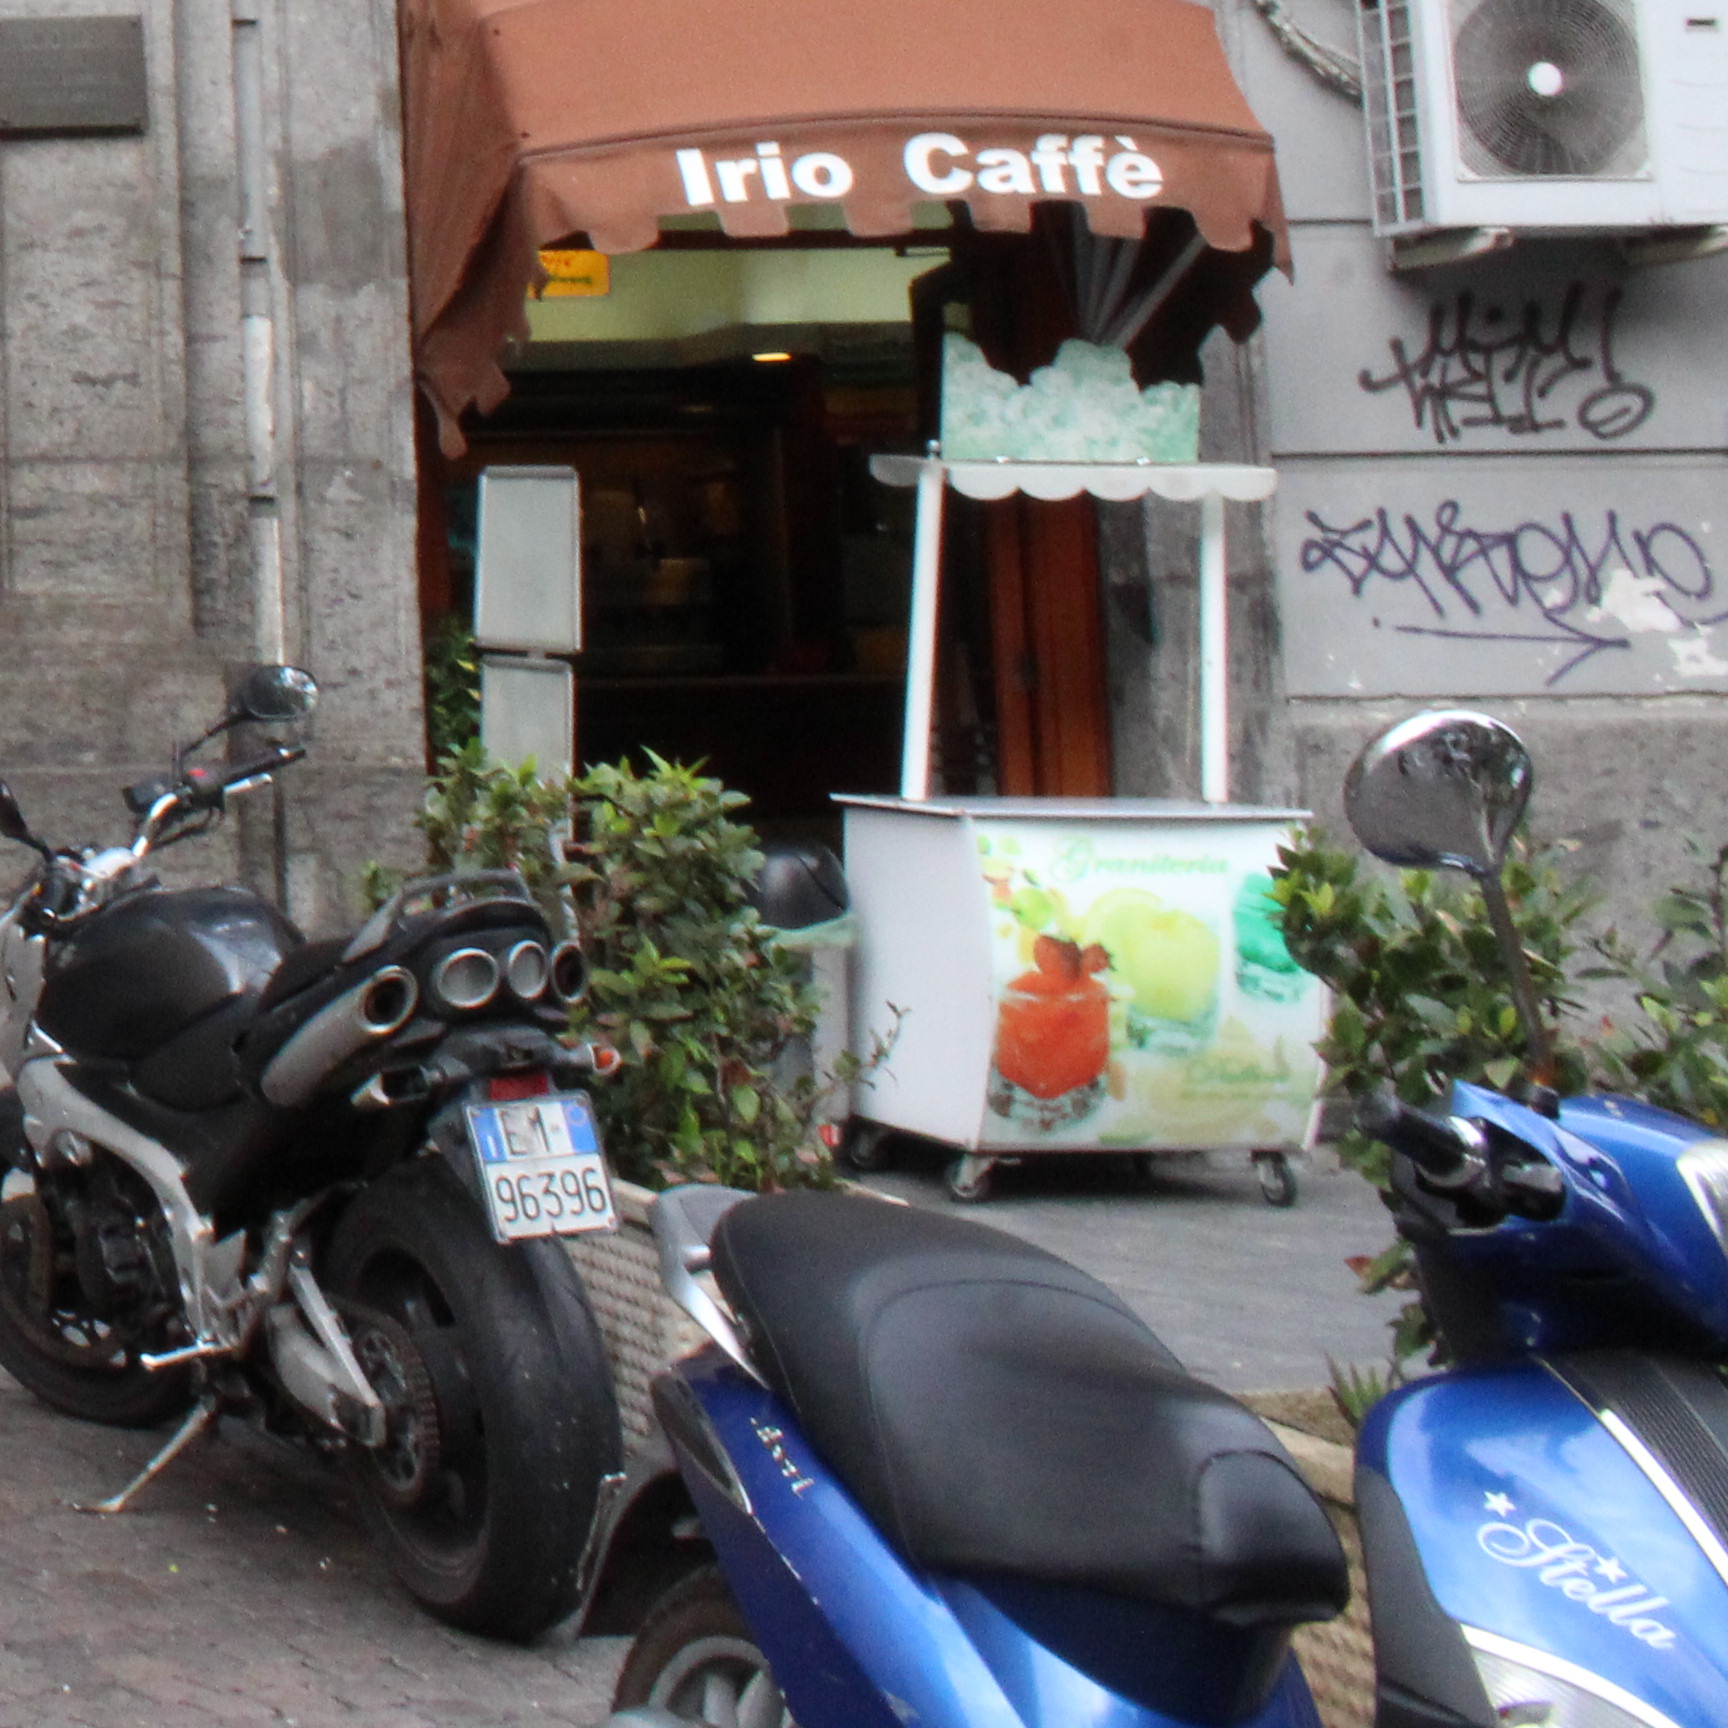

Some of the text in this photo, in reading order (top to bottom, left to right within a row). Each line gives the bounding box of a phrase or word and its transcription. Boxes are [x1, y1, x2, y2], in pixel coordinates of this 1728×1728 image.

[675, 131, 1164, 206] Irio Caffè
[495, 1166, 607, 1223] 96396
[1476, 1517, 1677, 1650] Stella
